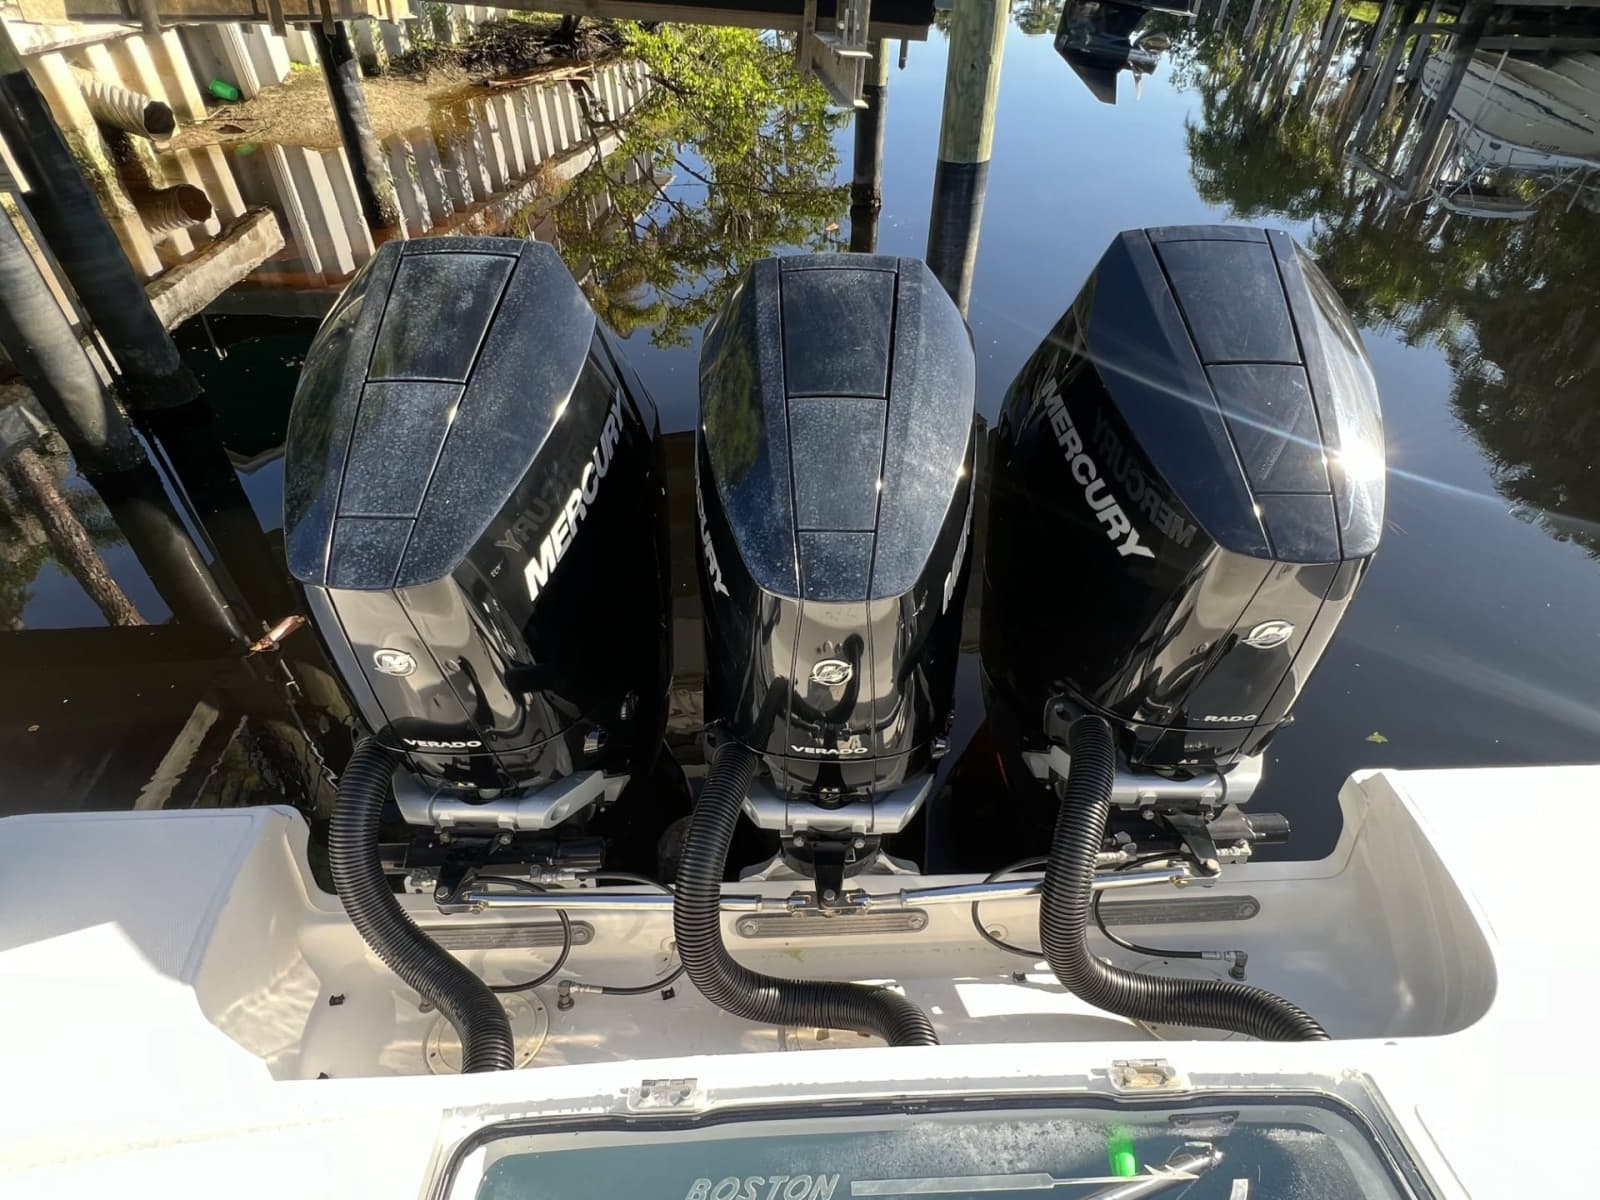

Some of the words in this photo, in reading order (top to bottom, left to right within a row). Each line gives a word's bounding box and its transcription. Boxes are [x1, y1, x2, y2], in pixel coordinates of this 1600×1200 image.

[1041, 377, 1155, 559] MERCURY
[523, 387, 623, 602] MERCURY
[1193, 714, 1258, 722] RADO
[403, 738, 482, 749] VERADO
[791, 744, 869, 755] VERADO
[685, 1173, 841, 1200] BOSTON
